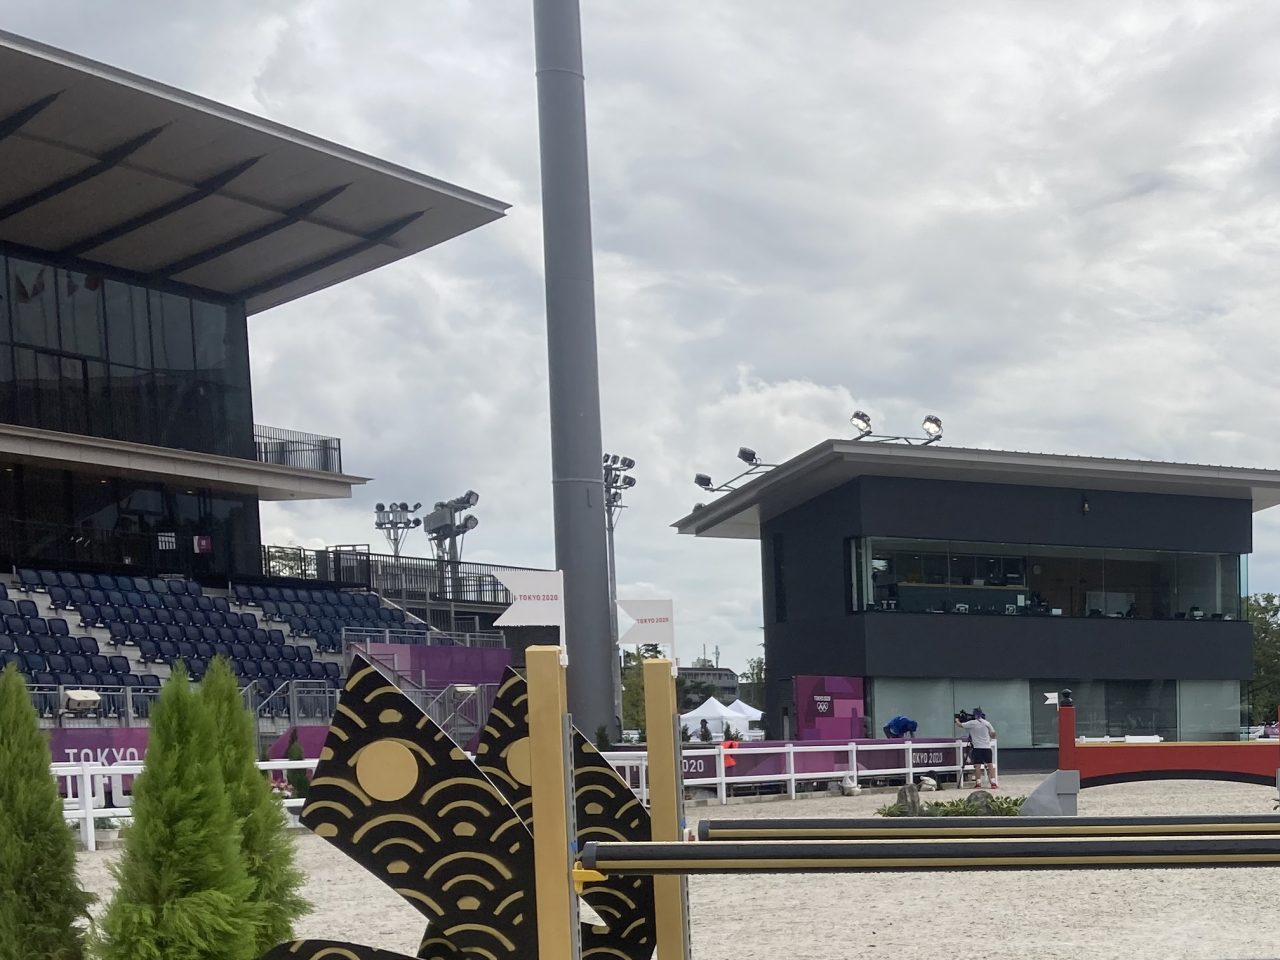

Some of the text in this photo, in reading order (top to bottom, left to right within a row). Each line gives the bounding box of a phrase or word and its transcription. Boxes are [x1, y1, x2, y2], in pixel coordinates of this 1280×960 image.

[64, 748, 139, 766] TOKYO
[912, 752, 928, 764] OKYO
[681, 759, 704, 773] 020
